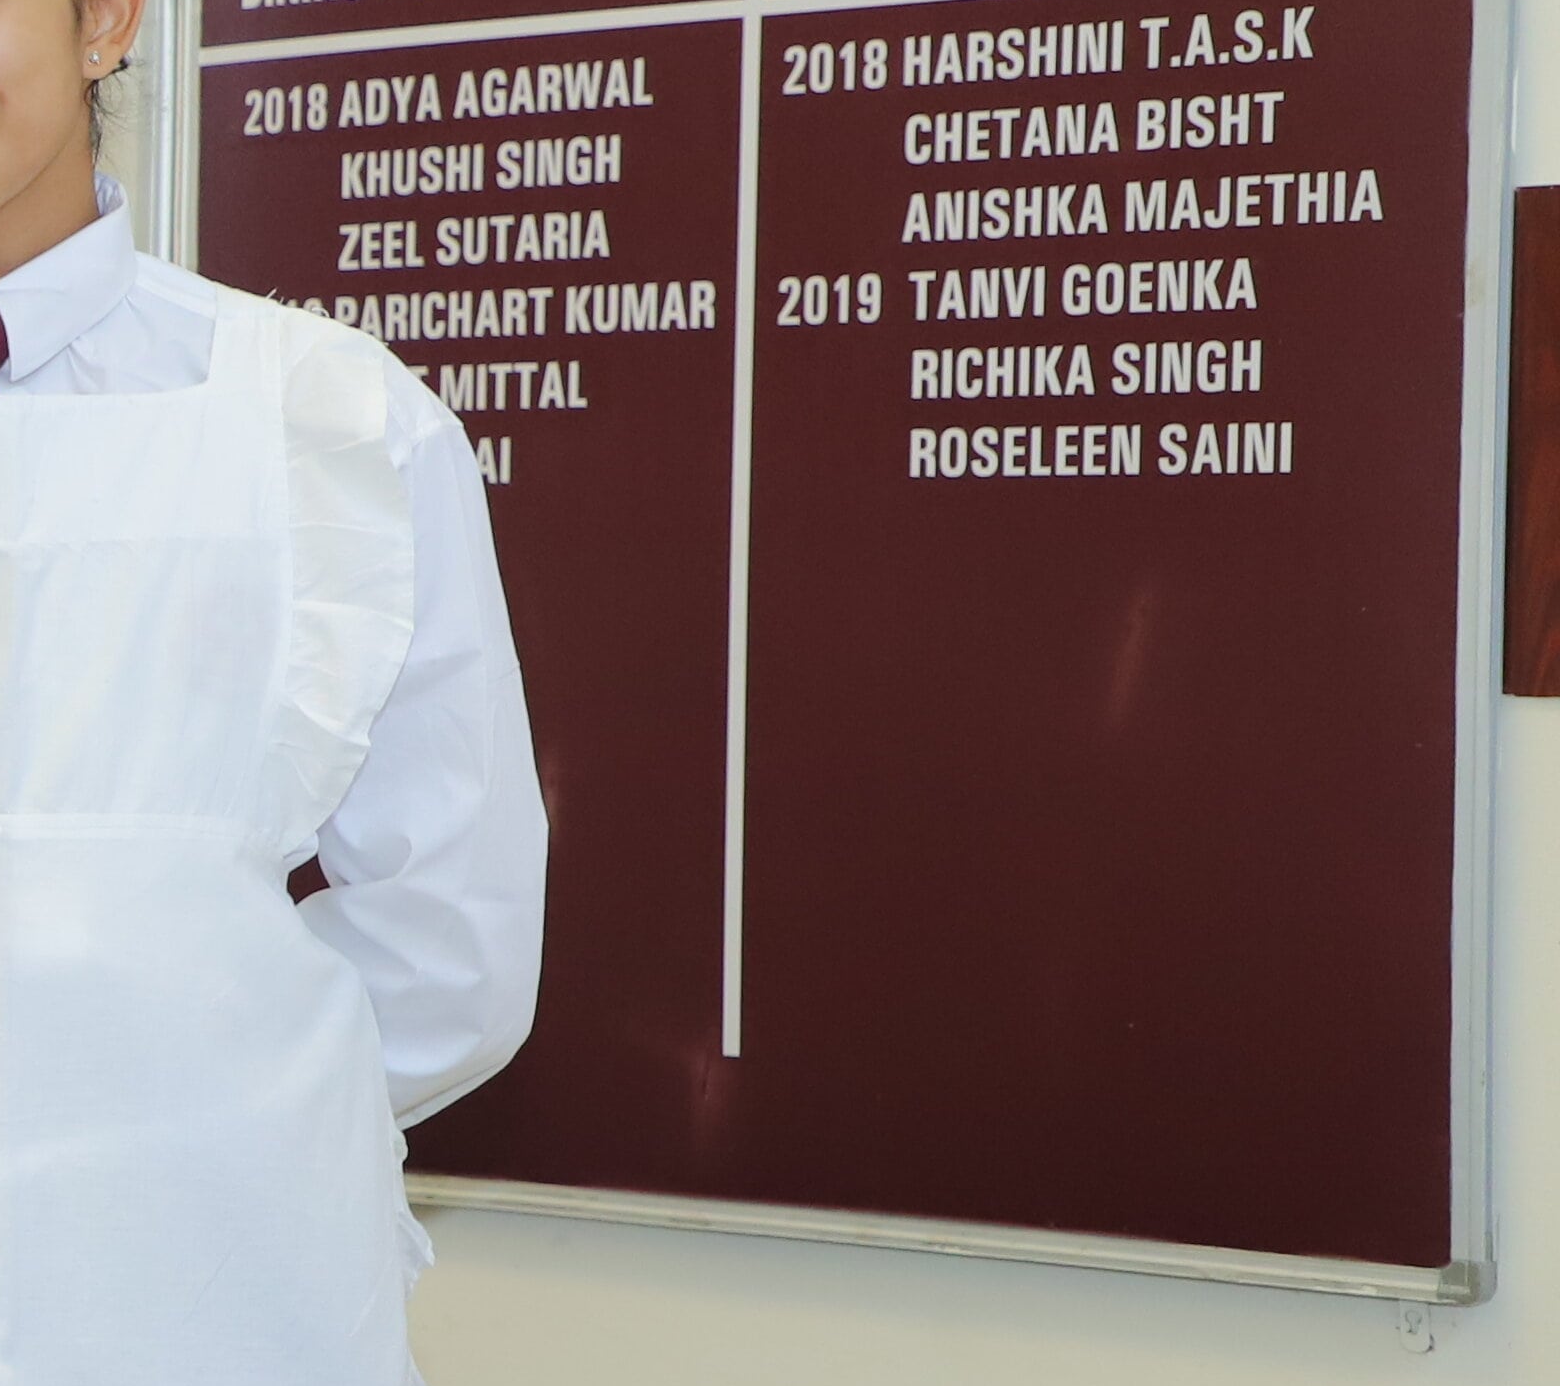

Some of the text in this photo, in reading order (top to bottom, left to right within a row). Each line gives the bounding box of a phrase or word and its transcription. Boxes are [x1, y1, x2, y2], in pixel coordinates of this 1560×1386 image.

[784, 7, 1313, 94] 2018 HARSHINI T.A.S.K
[244, 58, 652, 135] 2018 ADYA AGARWAL
[906, 92, 1283, 163] CHETANA BISHT
[342, 135, 620, 198] KHUSHI SINGH
[903, 170, 1382, 242] ANISHKA MAJETHIA
[339, 211, 609, 270] ZEEL SUTARIA
[334, 281, 715, 342] PARICHART KUMAR
[778, 259, 1256, 325] 2019 TANVI GOENKA
[437, 361, 587, 412] MITTAL
[912, 340, 1261, 398] RICHIKA SINGH
[910, 423, 1291, 477] ROSELEEN SAINI
